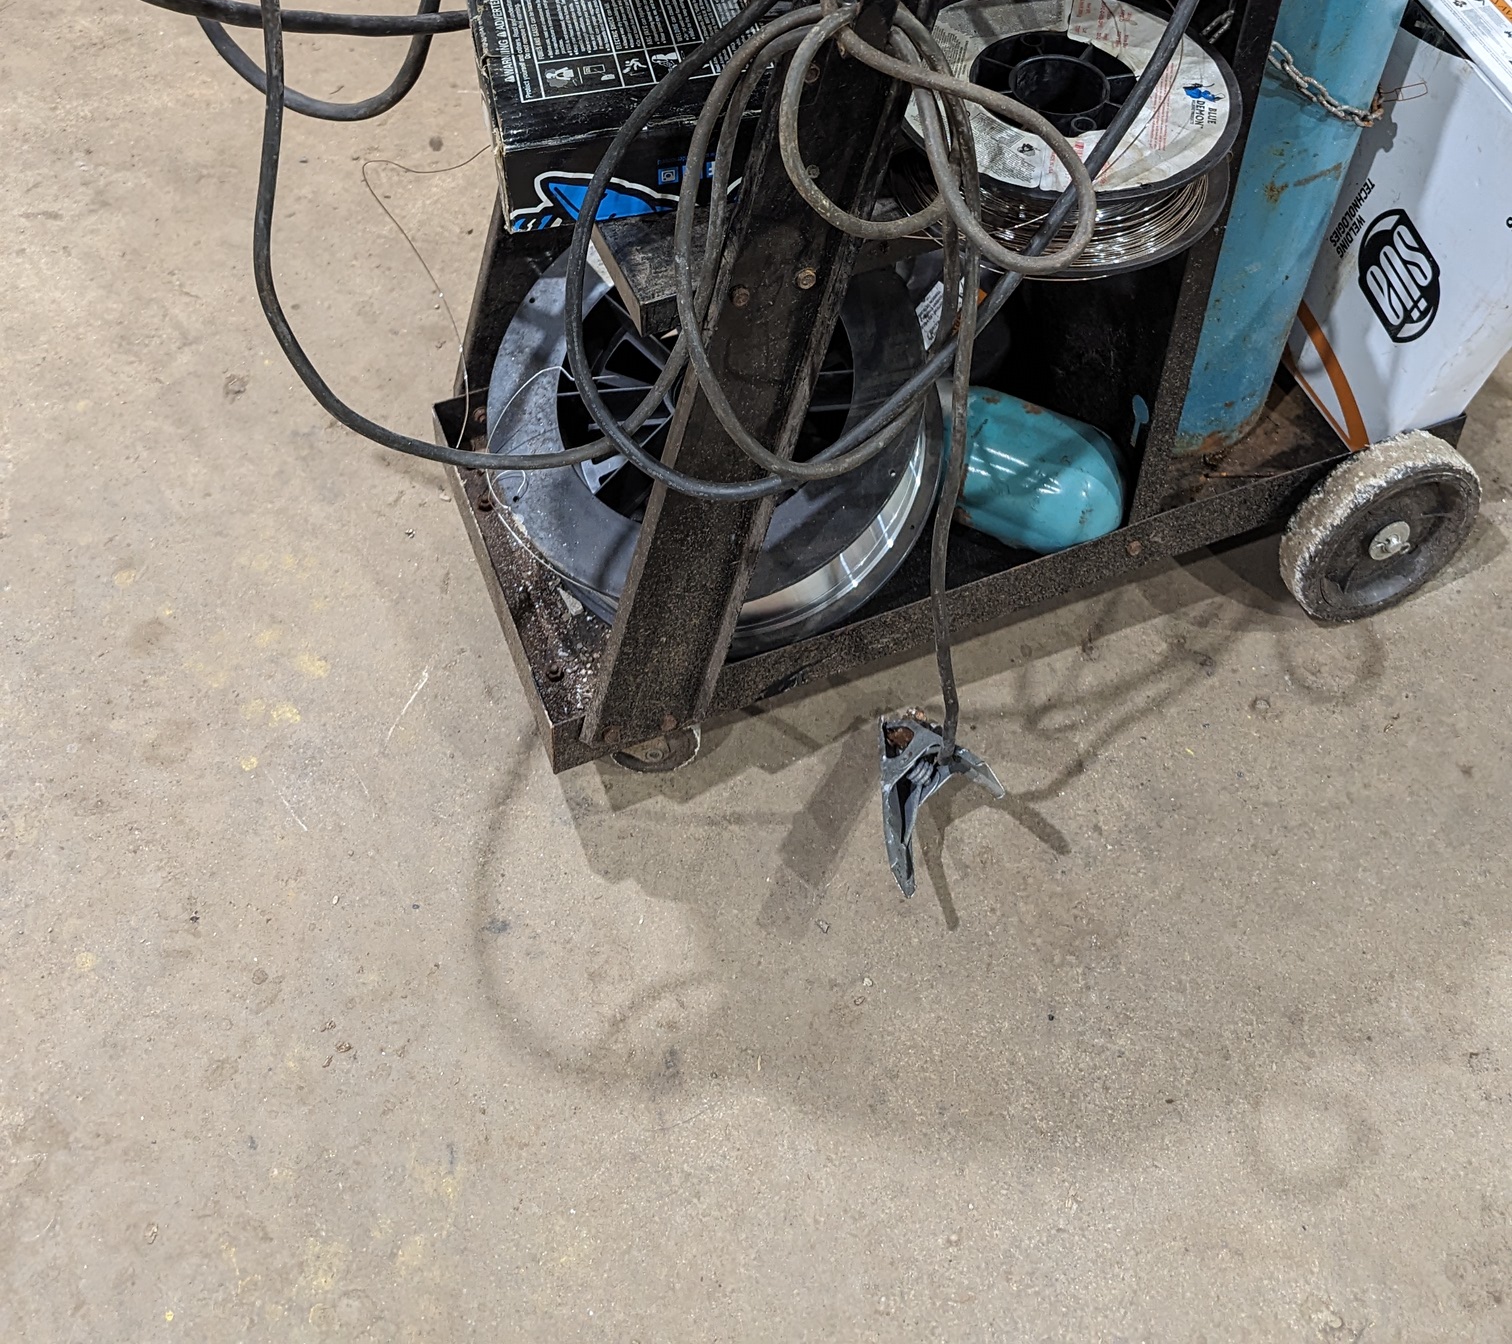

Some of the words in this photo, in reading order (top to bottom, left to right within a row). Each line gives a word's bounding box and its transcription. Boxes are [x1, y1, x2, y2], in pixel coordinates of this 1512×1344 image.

[497, 39, 514, 76] WARNING
[1207, 107, 1218, 126] BLUE
[1329, 177, 1376, 248] TECHNOLOGIES
[1336, 214, 1366, 259] WELDING
